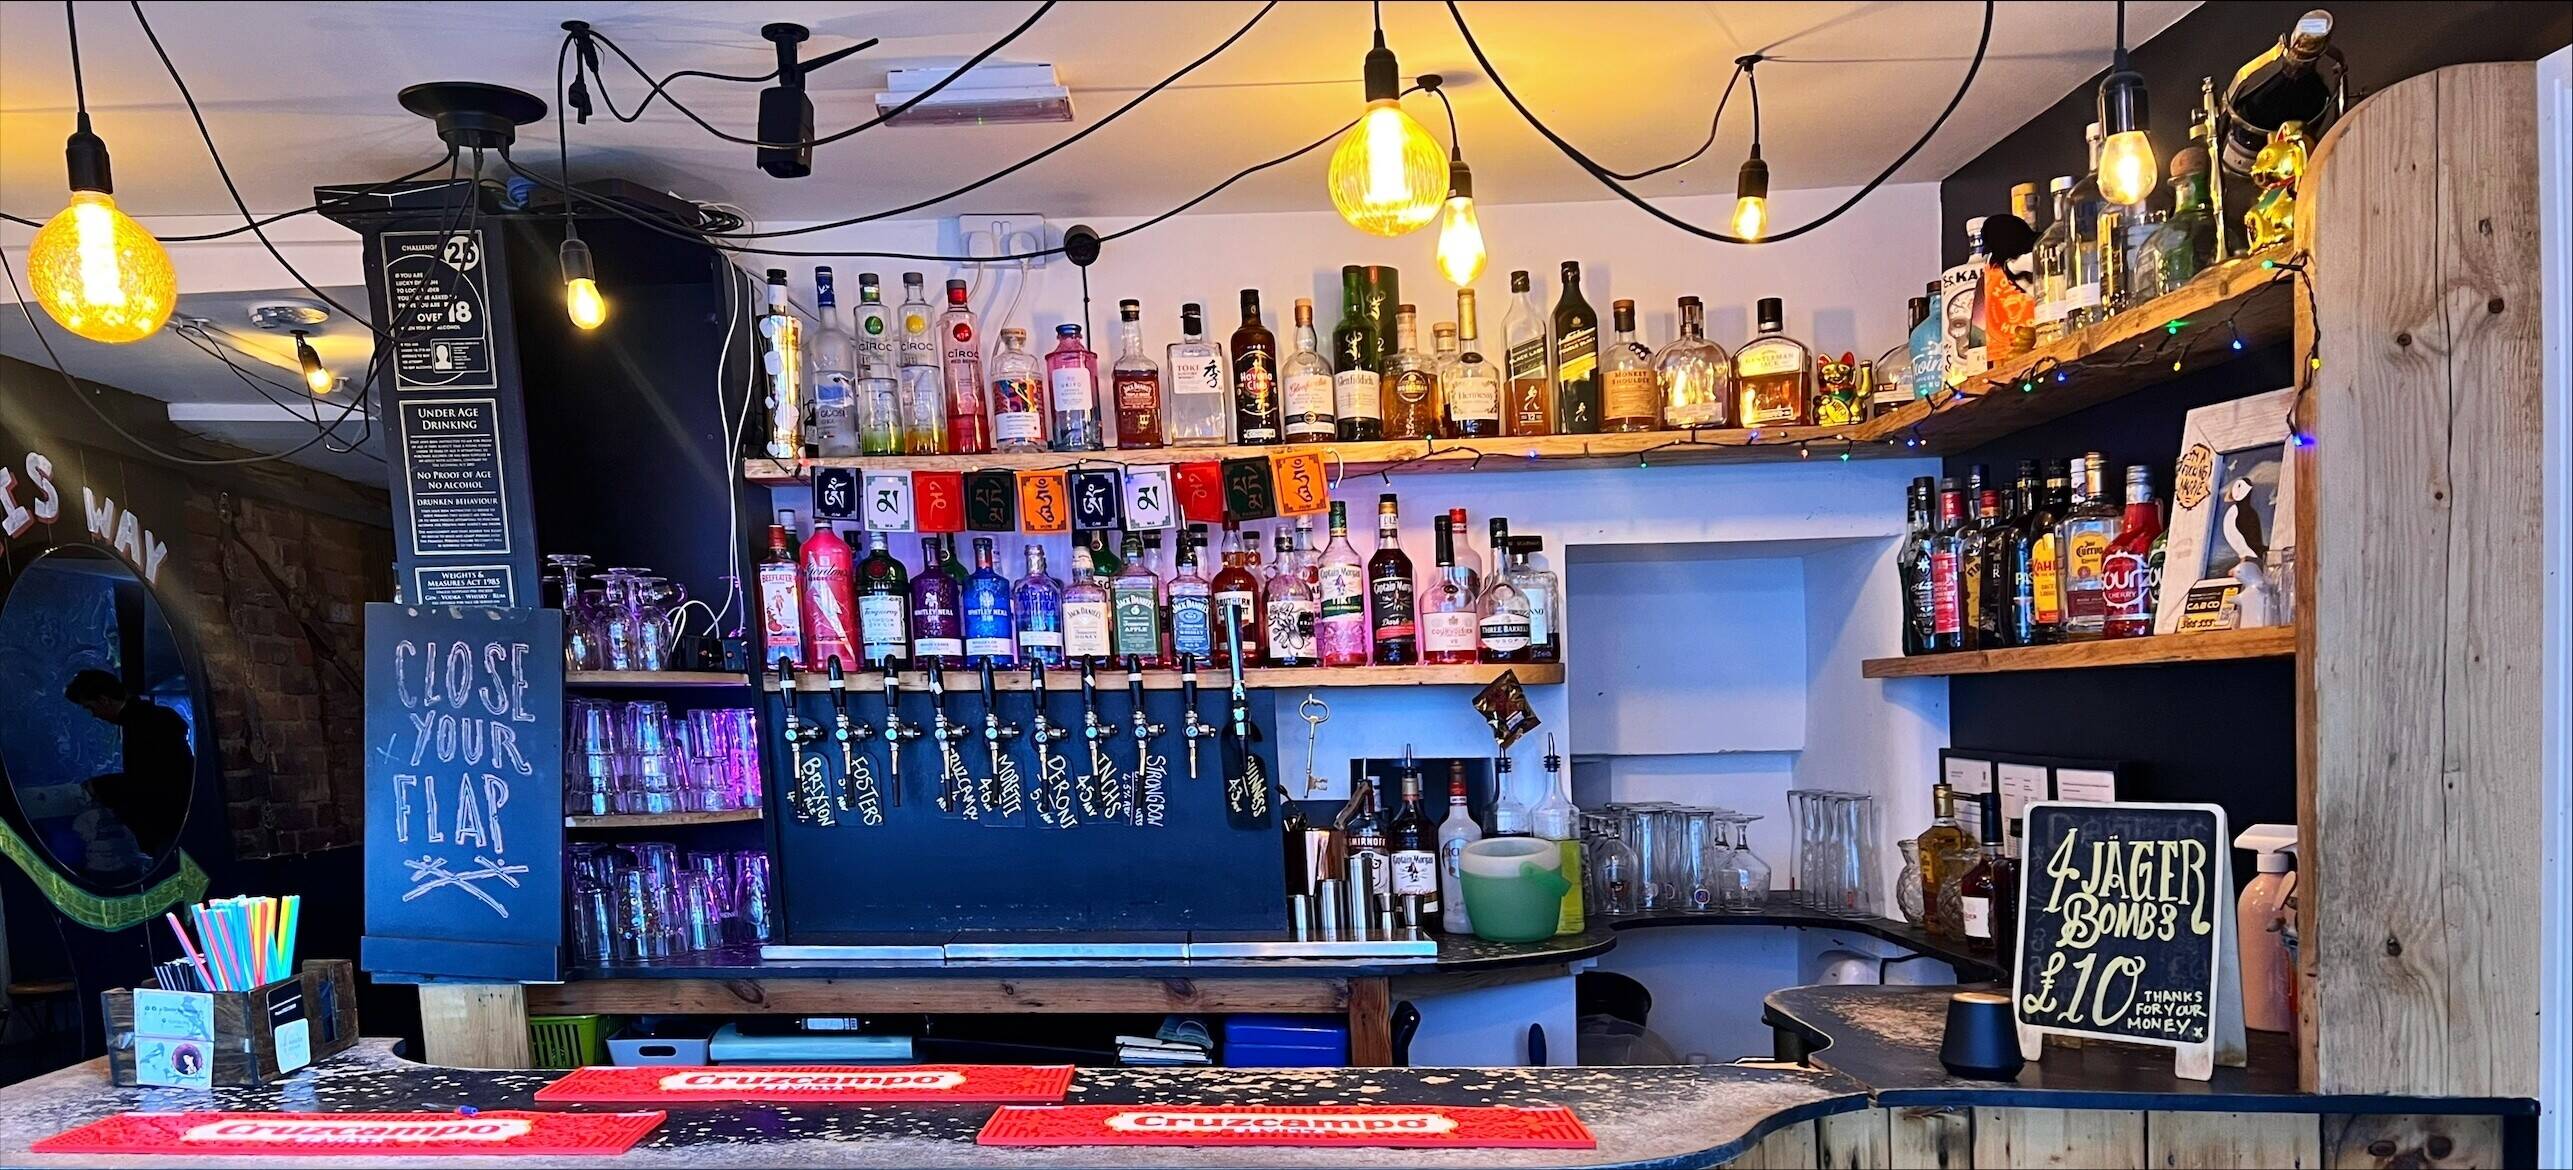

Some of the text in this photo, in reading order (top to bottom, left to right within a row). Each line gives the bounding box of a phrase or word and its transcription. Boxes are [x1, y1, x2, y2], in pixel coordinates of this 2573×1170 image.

[448, 300, 473, 323] 18
[1177, 364, 1200, 372] TOKI
[1458, 391, 1494, 400] Hennessy
[417, 407, 479, 418] UNDER AGE
[422, 419, 478, 430] DRINKING
[417, 470, 492, 480] NO PROOF OF AGE
[428, 481, 483, 490] NO ALCOHOL
[417, 497, 498, 507] DRUNKEN BEHAVIOUR
[83, 486, 168, 586] WAY
[441, 571, 485, 580] WEIGHTS &
[762, 574, 793, 583] BEEFEATER
[427, 580, 465, 588] MEASURES
[1116, 598, 1131, 610] JACK
[1172, 601, 1187, 614] JACK
[2186, 600, 2220, 611] CABCO
[1482, 625, 1502, 633] THREE
[395, 639, 536, 723] CLOSE
[410, 710, 533, 776] YOUR
[802, 757, 836, 827] BRIXTON
[851, 756, 883, 826] FOSTERS
[998, 753, 1022, 818] MORETTI
[1144, 755, 1167, 827] STRONGBOW
[393, 772, 510, 854] FLAP
[1348, 836, 1386, 847] SMIRNOFF
[2041, 827, 2081, 913] 4
[2080, 835, 2211, 935] JÄGER
[2022, 951, 2147, 1027] £10
[2144, 990, 2204, 1003] THANKS
[2135, 1002, 2208, 1018] FOR YOUR
[2127, 1017, 2192, 1034] MONEY
[684, 1073, 943, 1087] Cruzcampo
[1134, 1114, 1428, 1130] Cruzcampo
[215, 1121, 503, 1138] Cruzcampo
